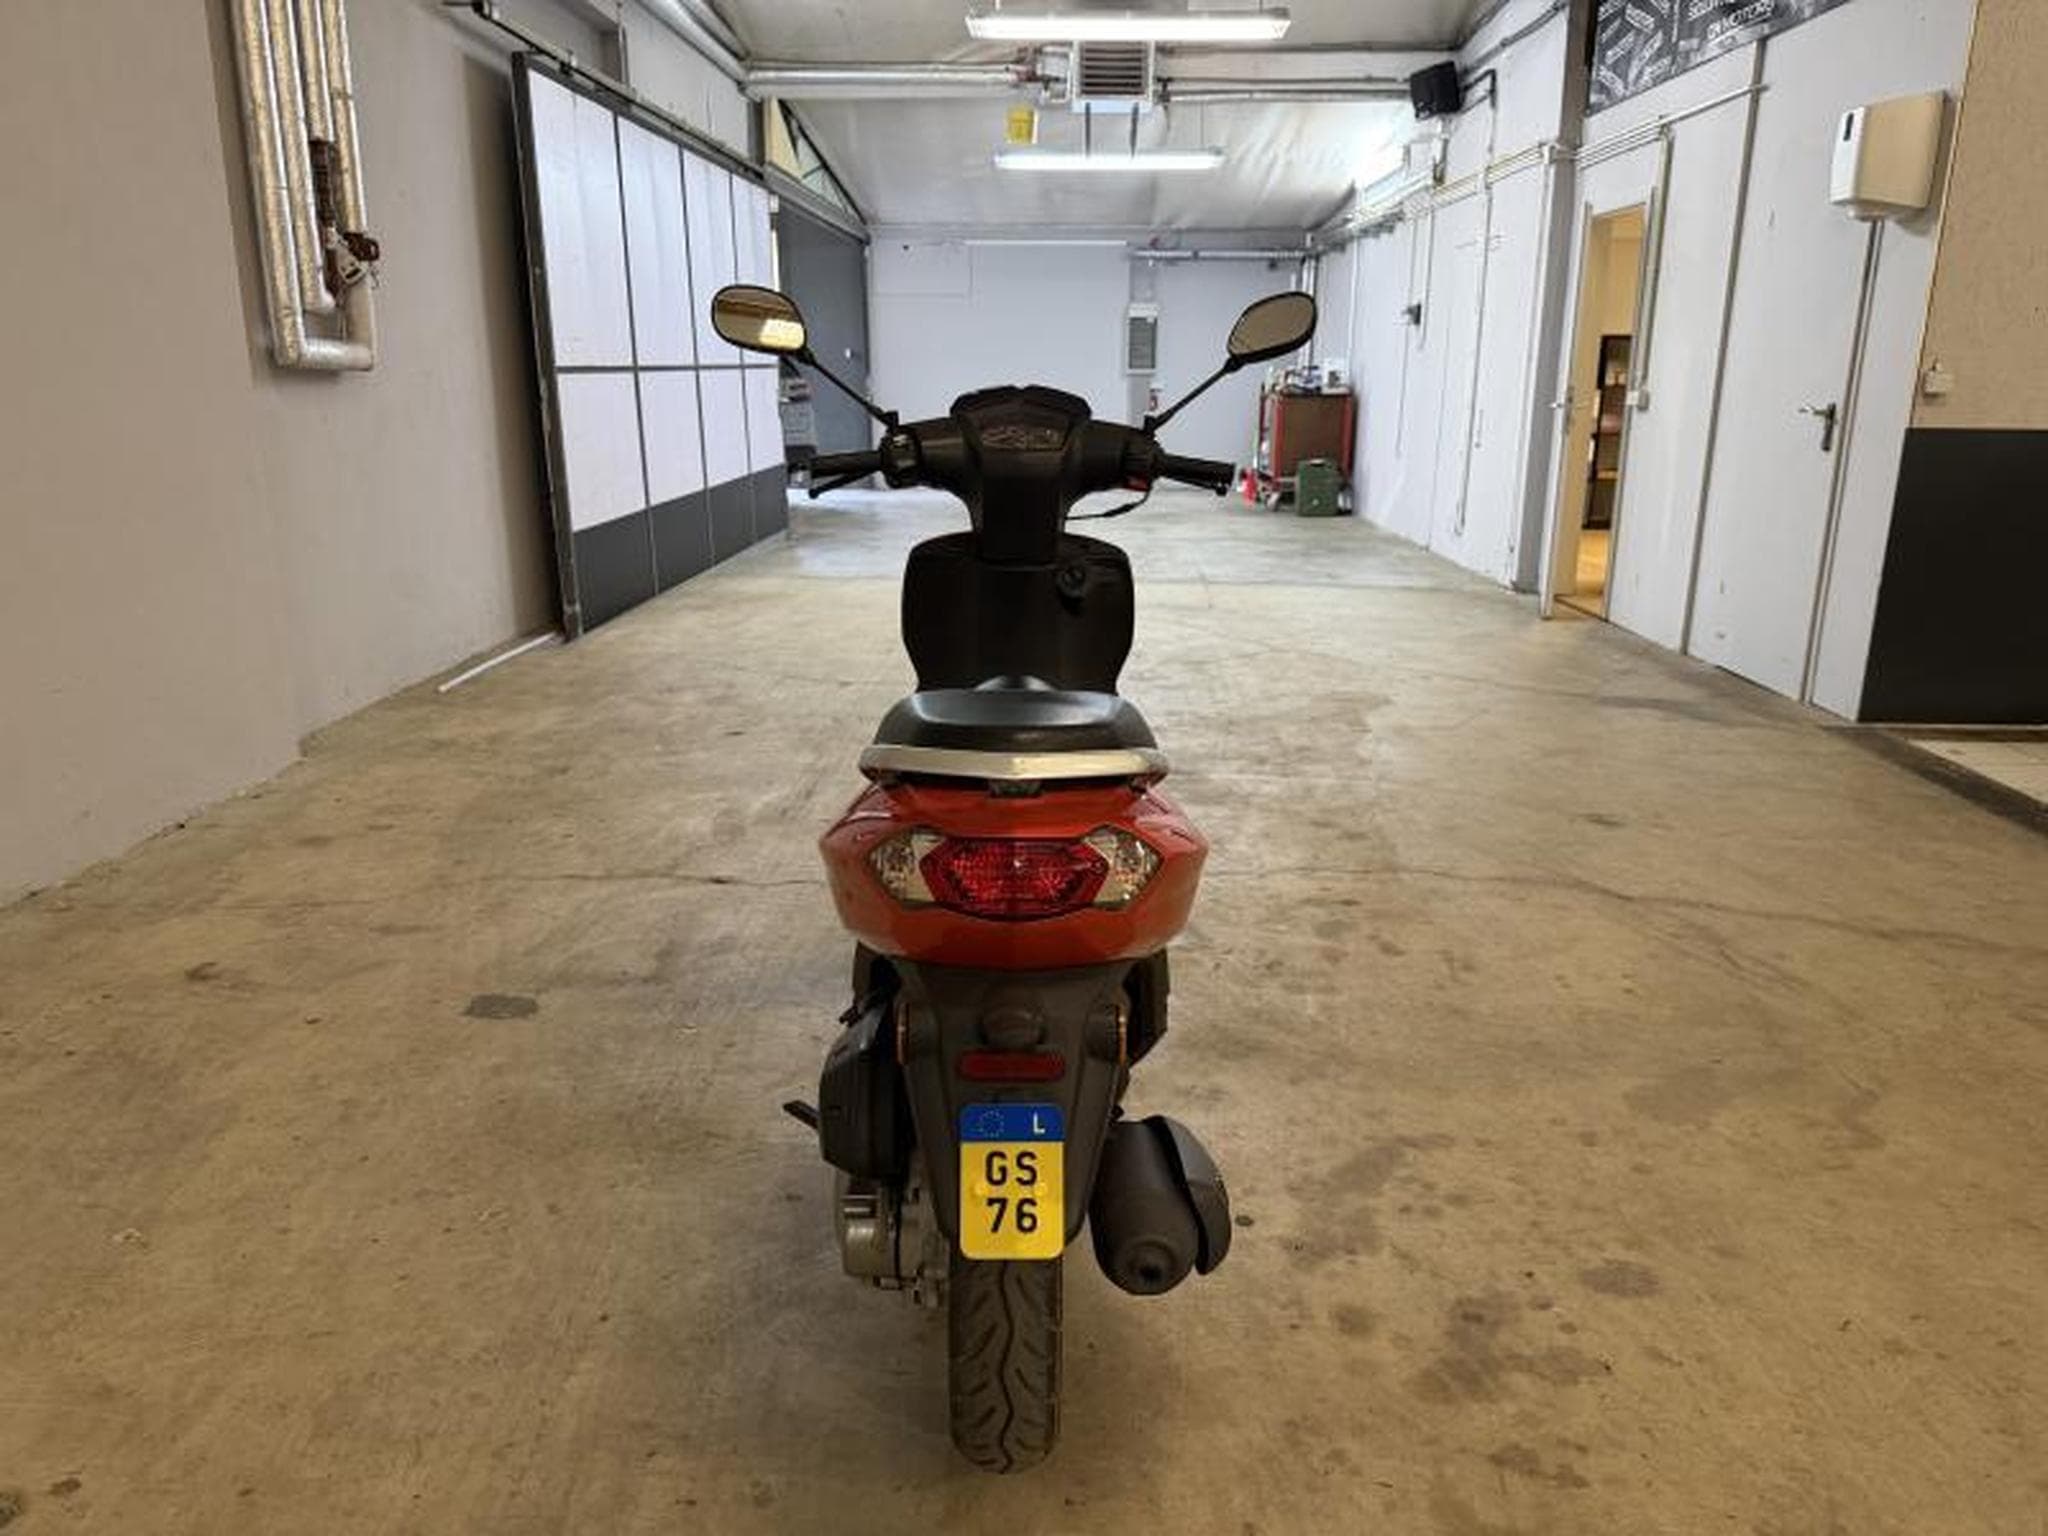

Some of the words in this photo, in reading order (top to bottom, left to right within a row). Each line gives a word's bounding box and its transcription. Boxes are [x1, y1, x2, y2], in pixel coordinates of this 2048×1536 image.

[1033, 1112, 1045, 1133] L
[985, 1151, 1038, 1186] GS
[986, 1198, 1038, 1234] 76
